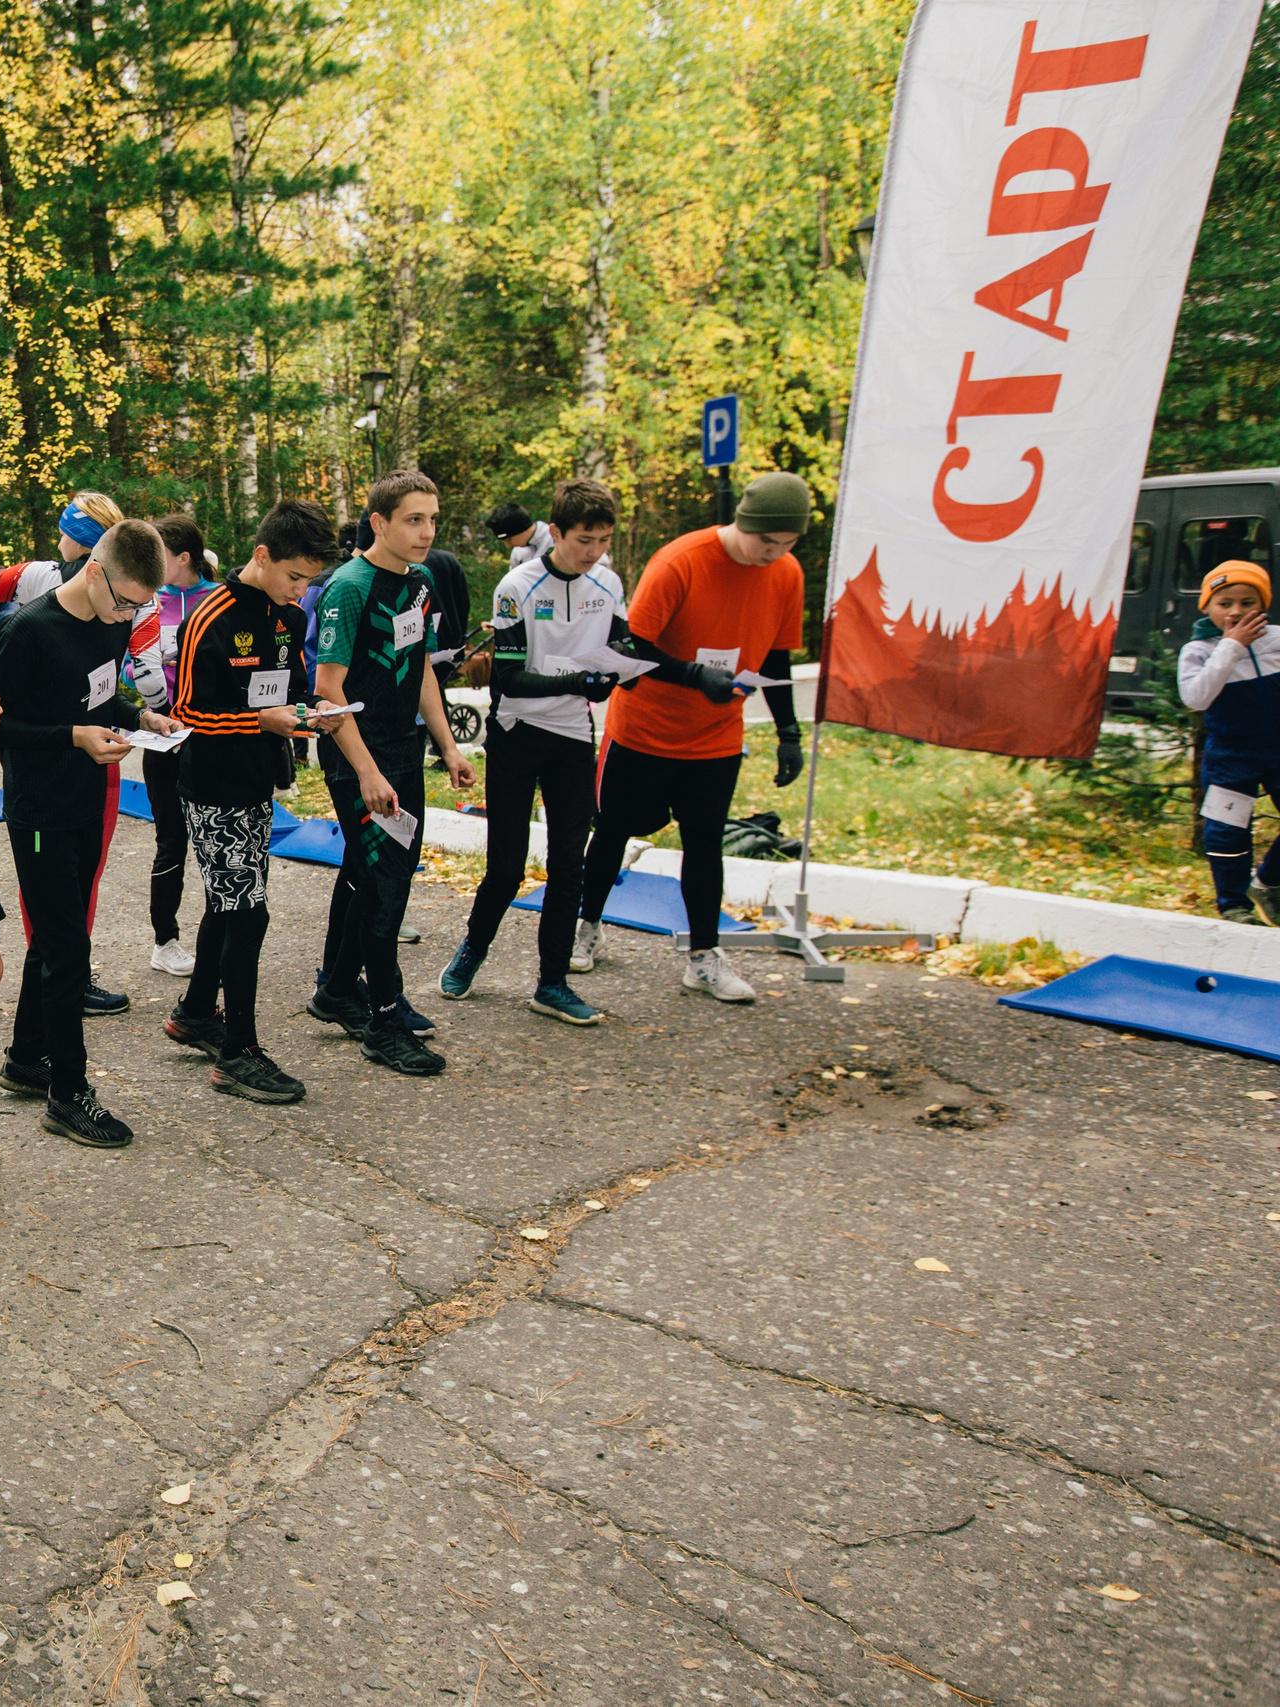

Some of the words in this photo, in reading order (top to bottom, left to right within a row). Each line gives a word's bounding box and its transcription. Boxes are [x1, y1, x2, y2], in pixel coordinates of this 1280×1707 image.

[933, 20, 1150, 543] СТАРТ
[708, 407, 731, 457] P
[403, 622, 417, 638] 202
[97, 678, 109, 695] 201
[258, 683, 278, 696] 210
[1224, 802, 1234, 811] 4
